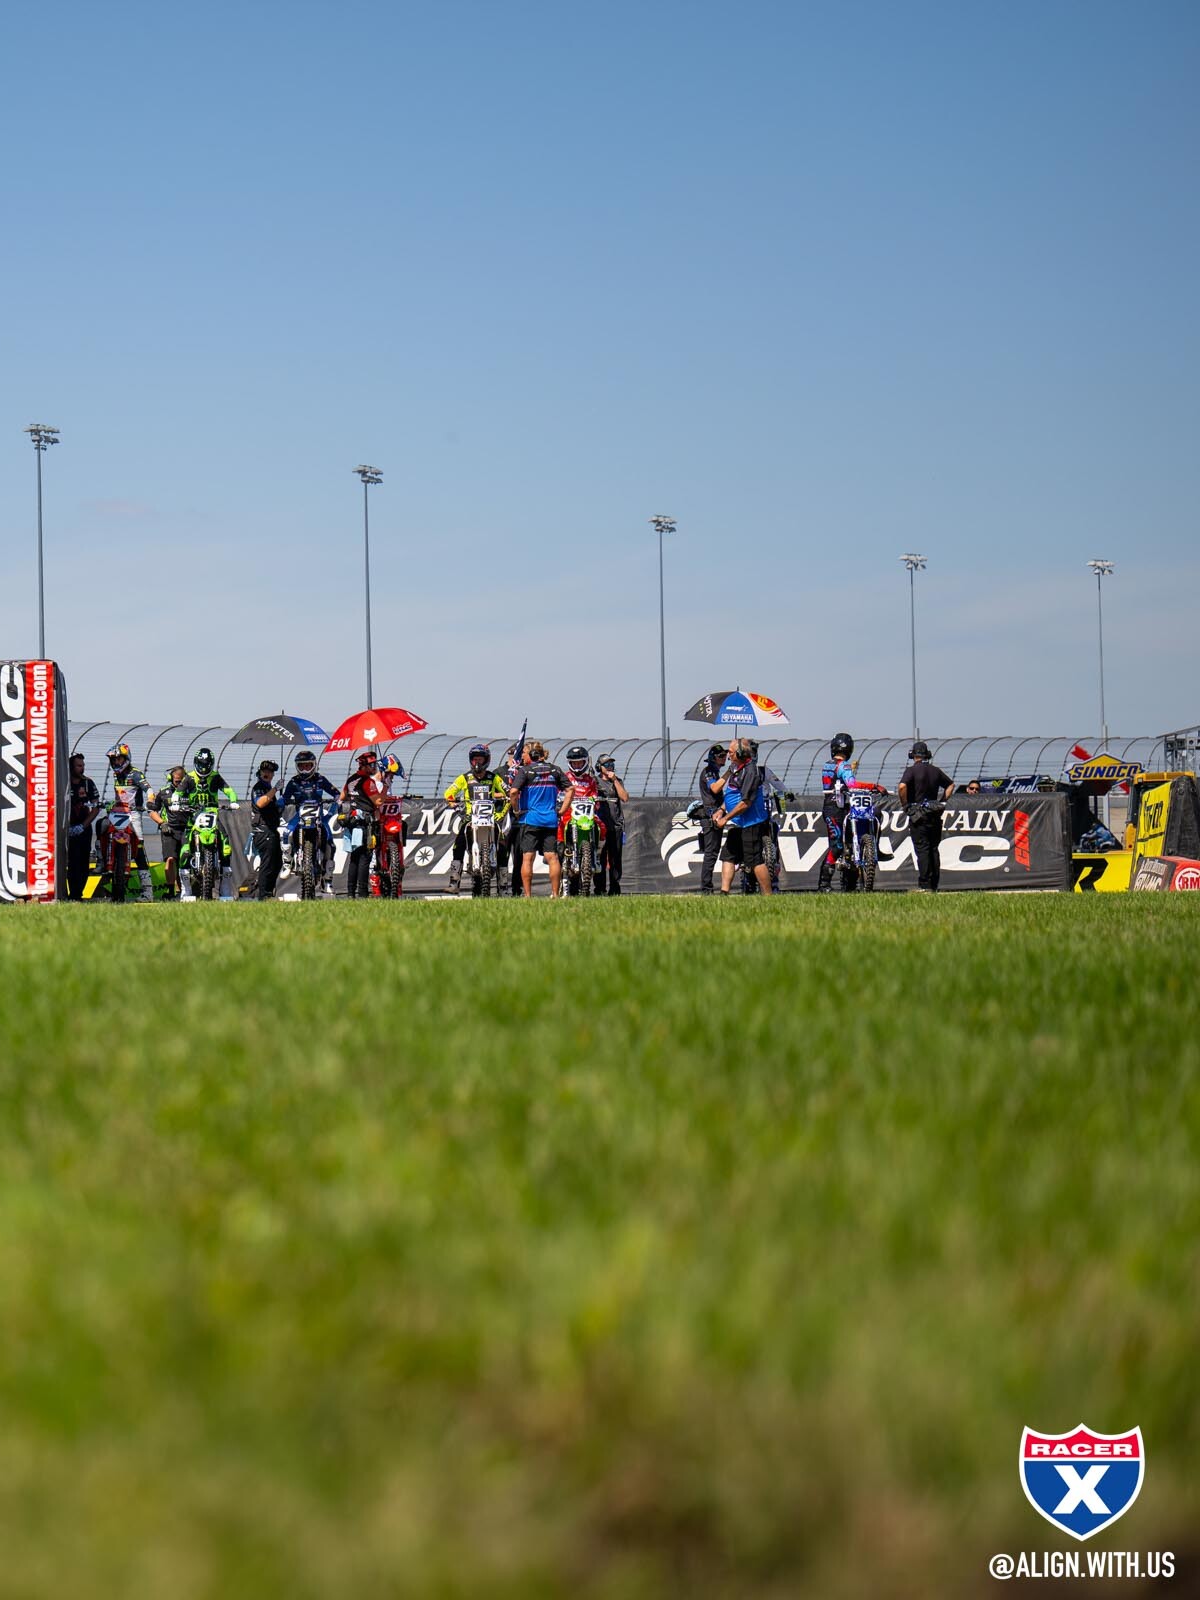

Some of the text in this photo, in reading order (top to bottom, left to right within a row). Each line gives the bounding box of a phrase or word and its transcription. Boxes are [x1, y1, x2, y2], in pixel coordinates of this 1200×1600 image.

[331, 738, 350, 749] FOX
[1072, 764, 1141, 779] SUNOCO
[853, 797, 870, 807] 36
[382, 804, 399, 814] 18
[575, 804, 593, 815] 91
[113, 815, 130, 826] 7
